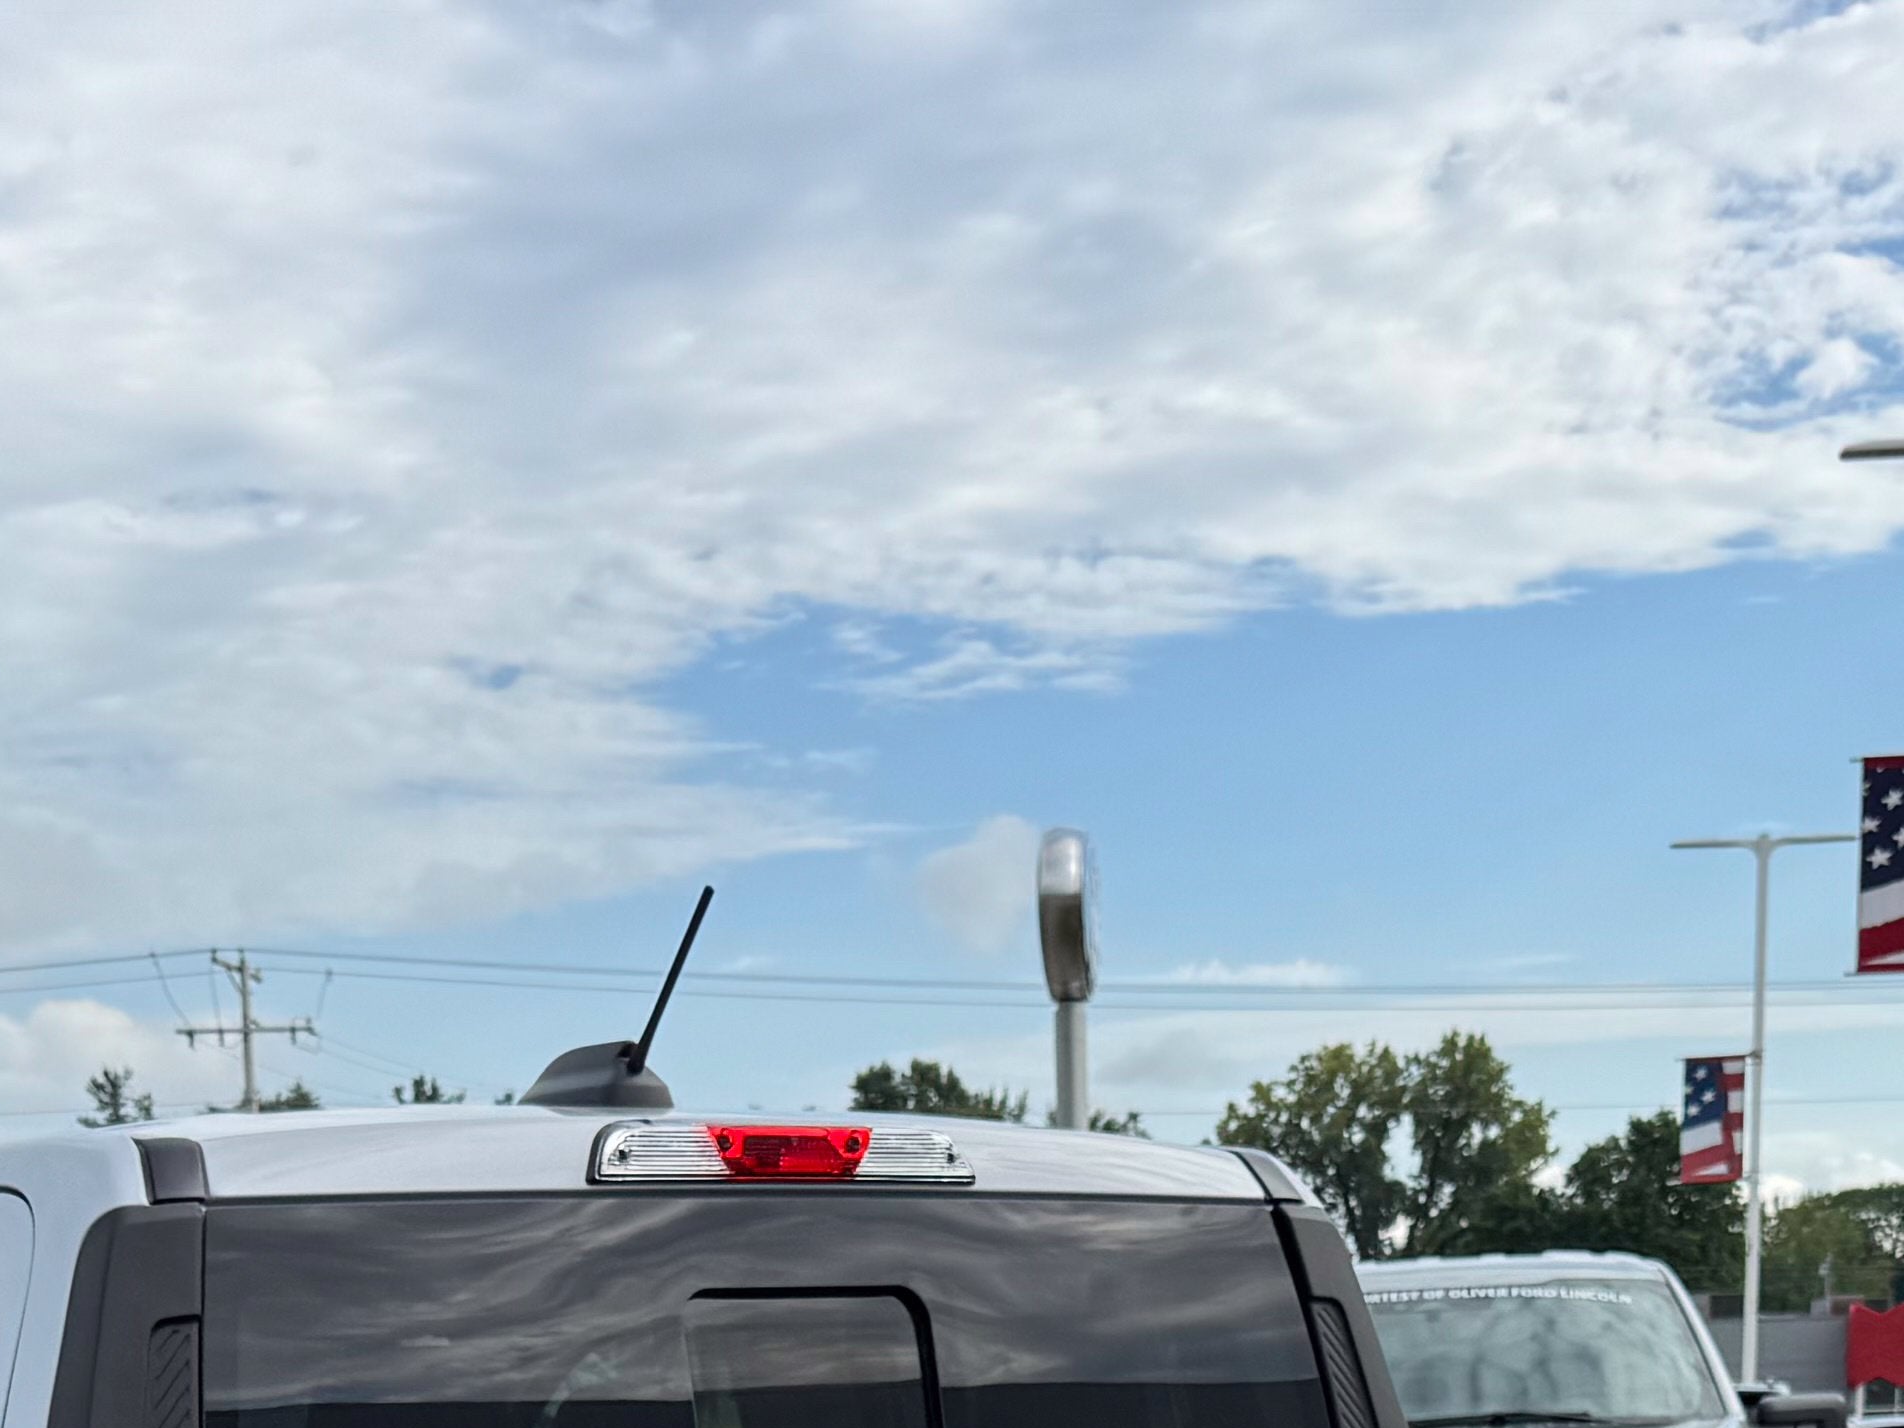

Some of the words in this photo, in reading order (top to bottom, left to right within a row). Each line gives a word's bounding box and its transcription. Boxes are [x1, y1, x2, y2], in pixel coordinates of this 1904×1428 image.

[1448, 1286, 1509, 1300] OLIVER
[1510, 1286, 1557, 1299] FORD
[1559, 1285, 1633, 1305] LINCOLN
